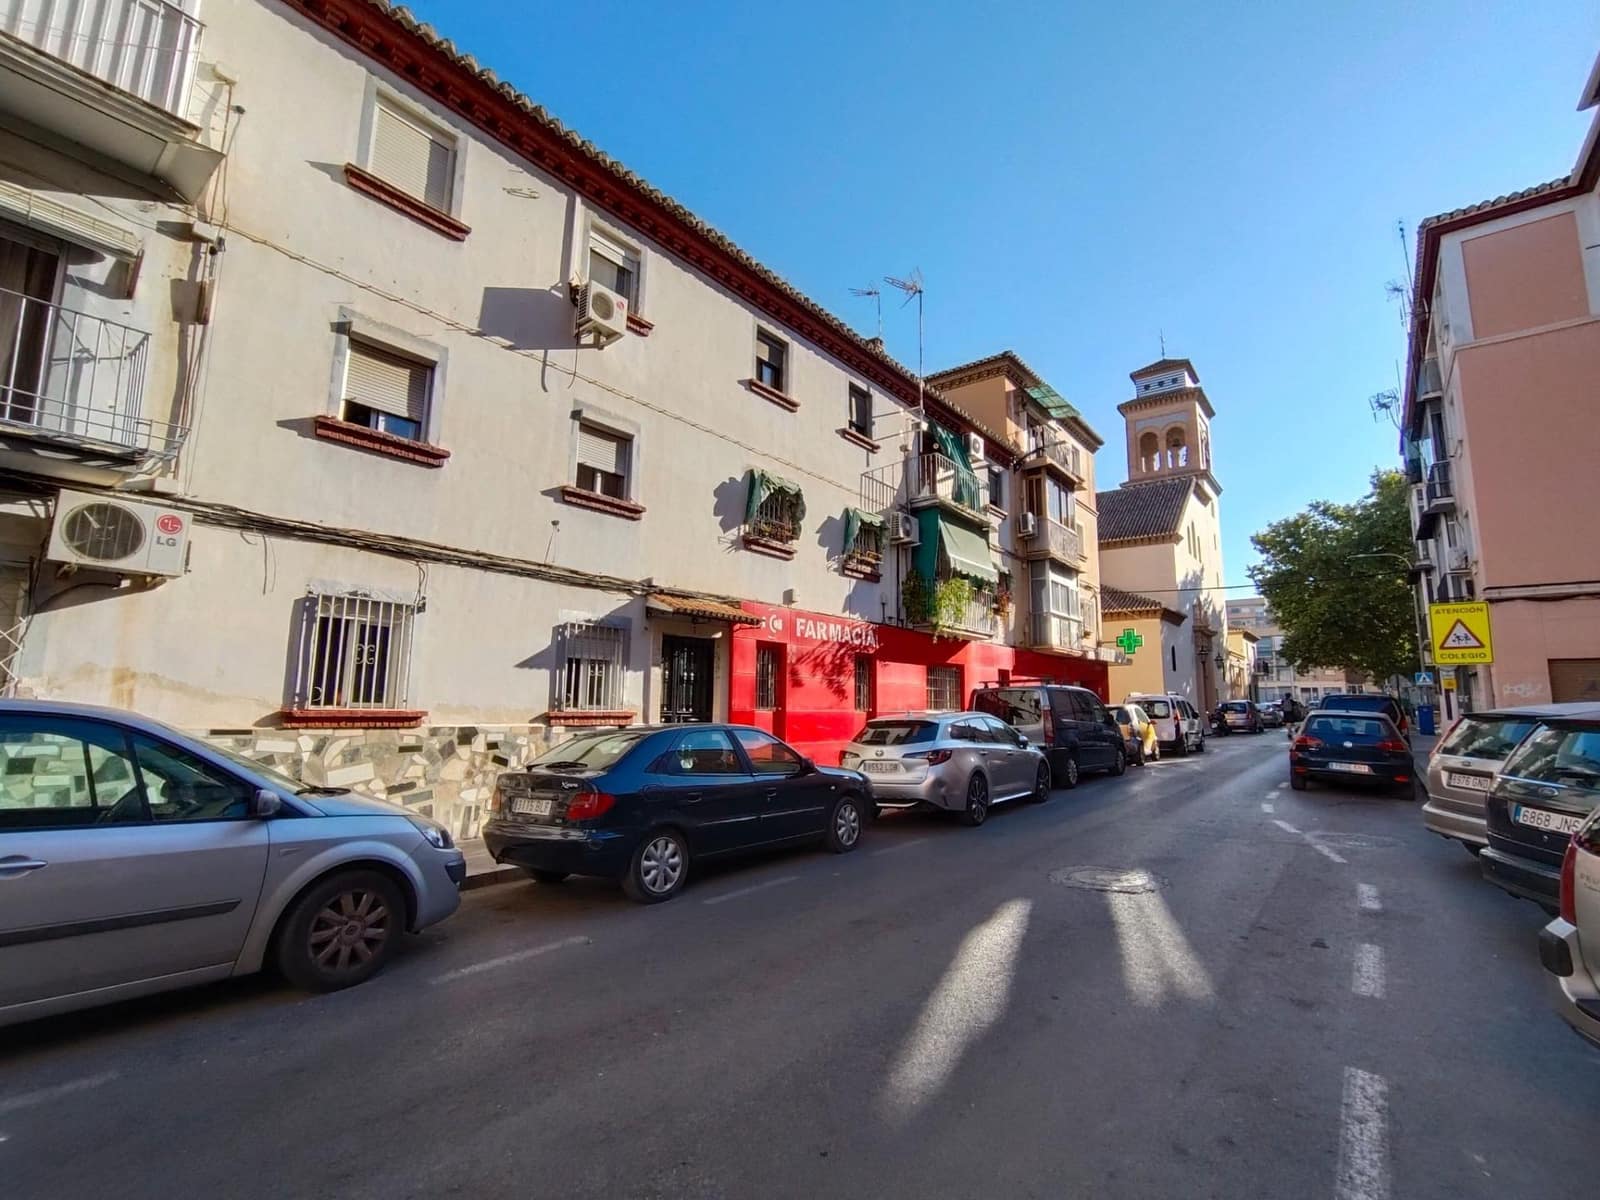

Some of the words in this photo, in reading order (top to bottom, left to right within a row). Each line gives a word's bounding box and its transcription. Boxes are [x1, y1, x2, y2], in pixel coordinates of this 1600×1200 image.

[156, 535, 177, 547] LG
[796, 617, 878, 649] FARMACIA
[1439, 652, 1487, 660] COLEGIO
[1522, 809, 1551, 828] 6868
